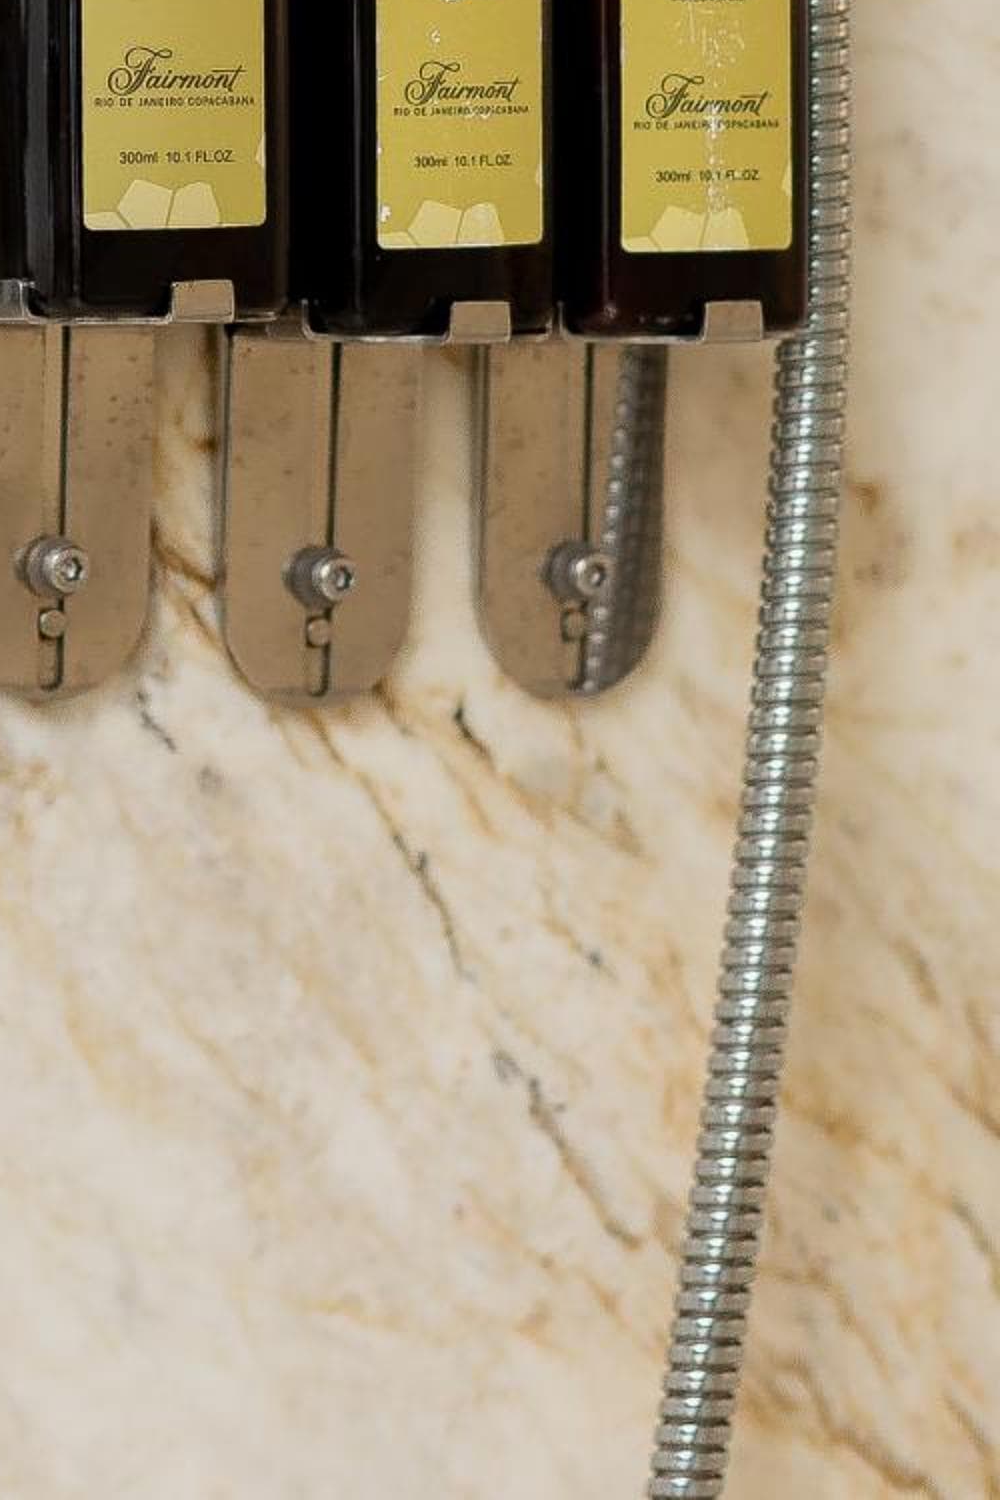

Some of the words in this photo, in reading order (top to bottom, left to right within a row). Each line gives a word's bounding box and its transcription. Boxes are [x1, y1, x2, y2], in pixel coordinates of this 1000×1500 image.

[107, 47, 247, 96] Fairmont
[404, 61, 520, 106] Fairmont
[94, 97, 114, 108] RIO
[119, 97, 133, 107] DE
[138, 96, 184, 107] JANEIRO
[187, 95, 255, 107] COPACABANA
[645, 74, 768, 119] Fairmont
[393, 107, 411, 117] RIO
[413, 106, 426, 117] DE
[634, 121, 650, 130] RIO
[656, 120, 668, 130] DE
[119, 151, 158, 165] 300ml
[655, 170, 691, 182] 300ml
